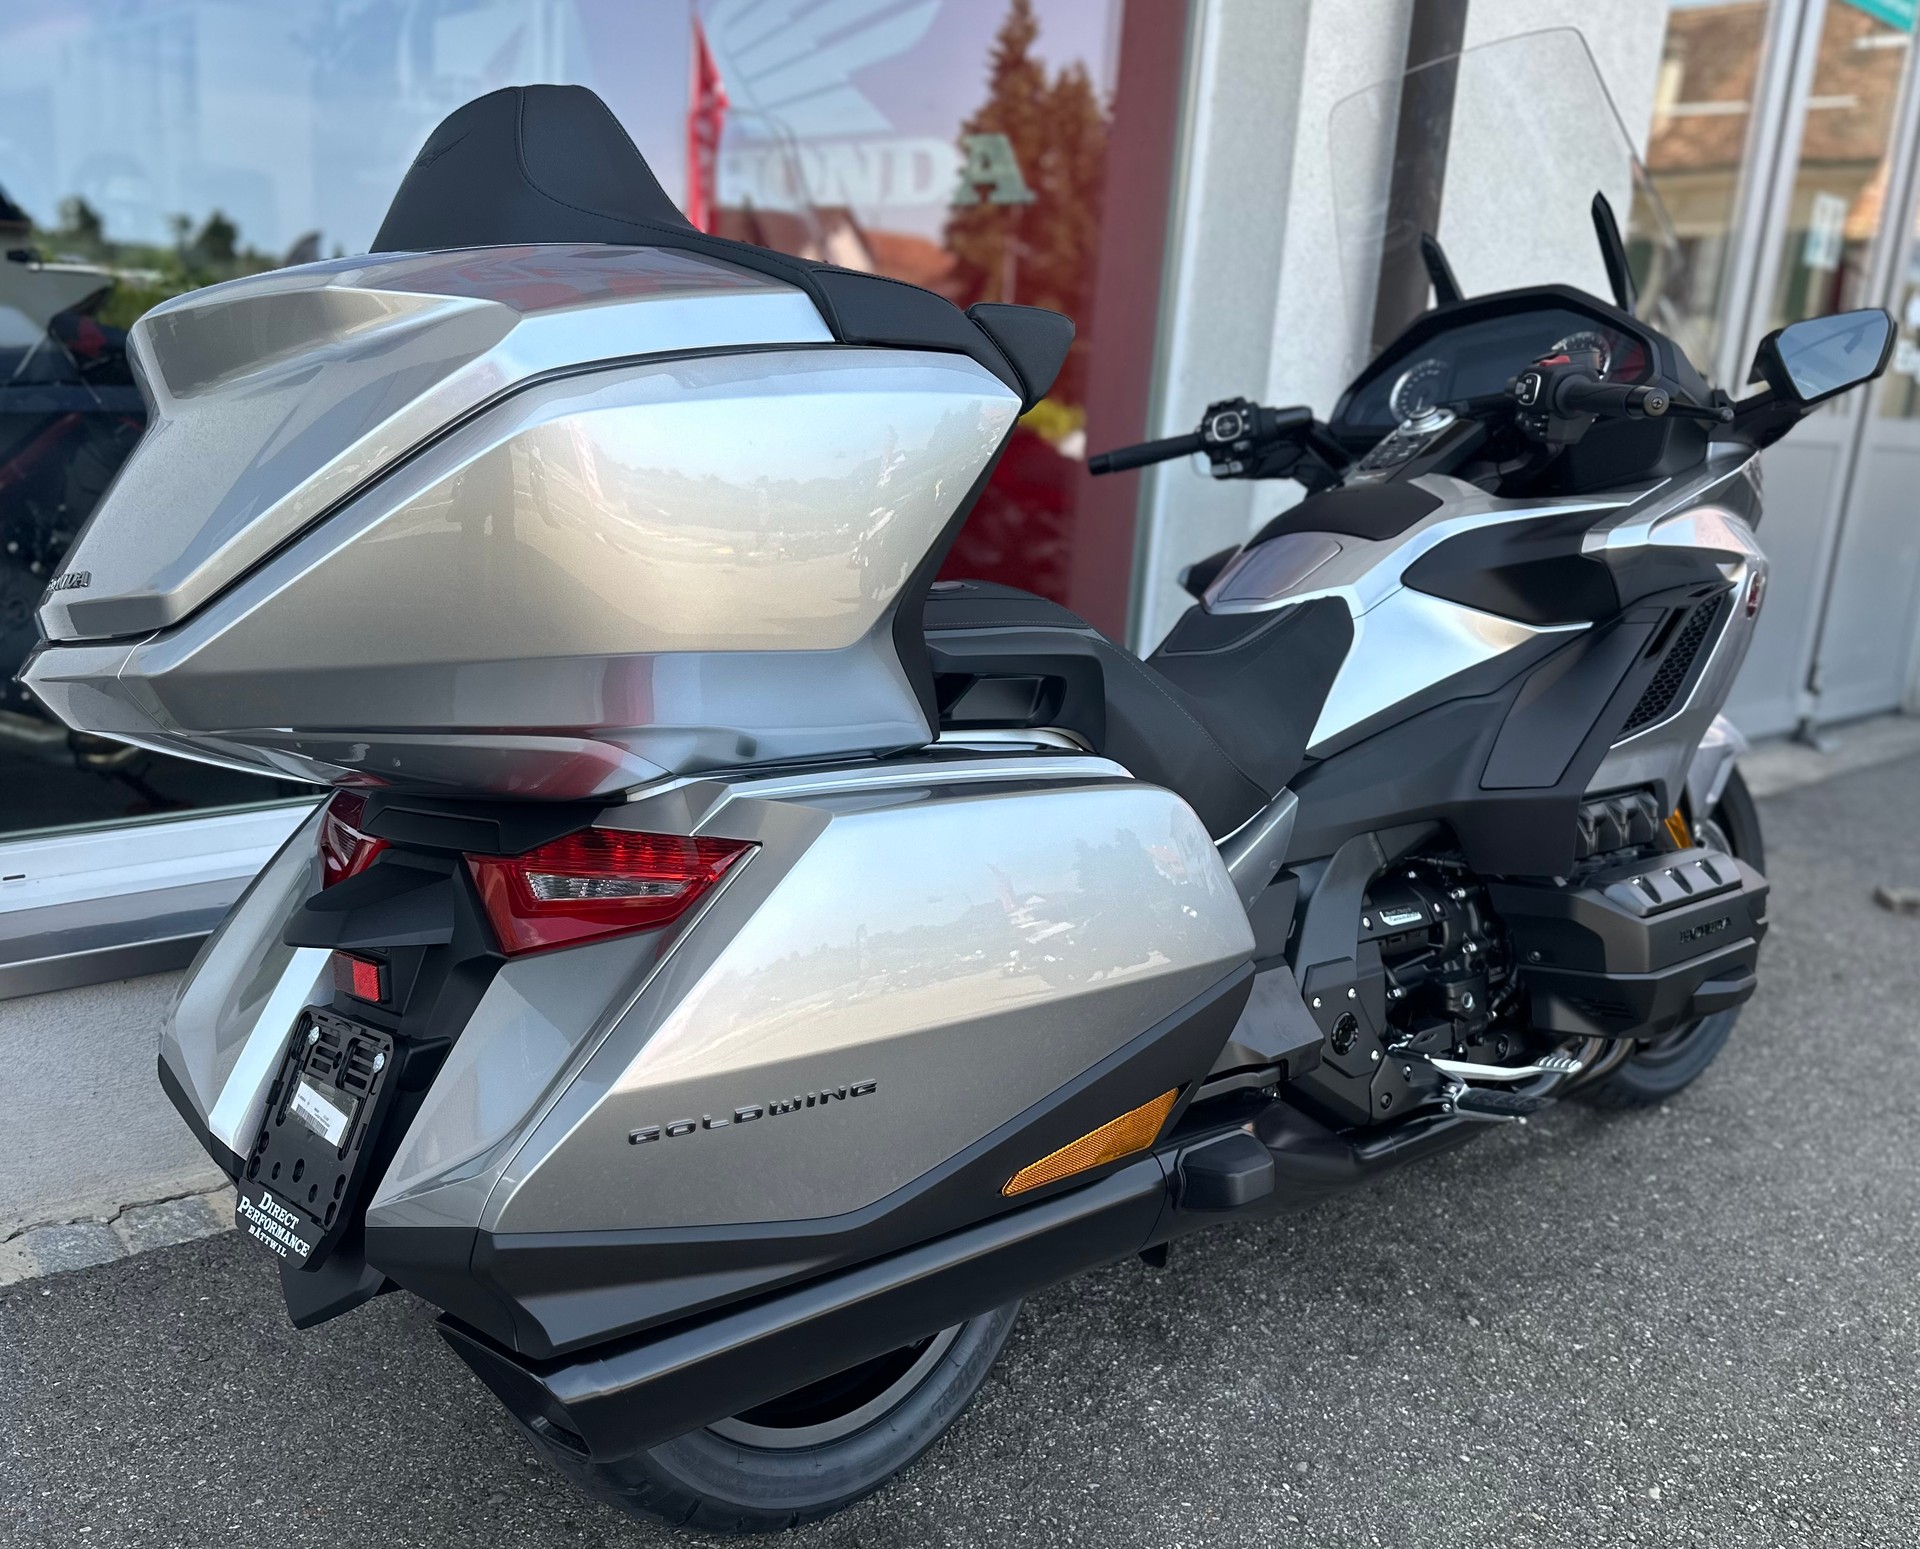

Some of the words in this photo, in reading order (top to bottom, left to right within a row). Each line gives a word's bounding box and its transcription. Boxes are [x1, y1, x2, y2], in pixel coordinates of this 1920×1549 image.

[628, 1078, 877, 1145] GOLDWING
[237, 1195, 311, 1257] PERFORMANCE
[258, 1191, 300, 1230] DIRECT
